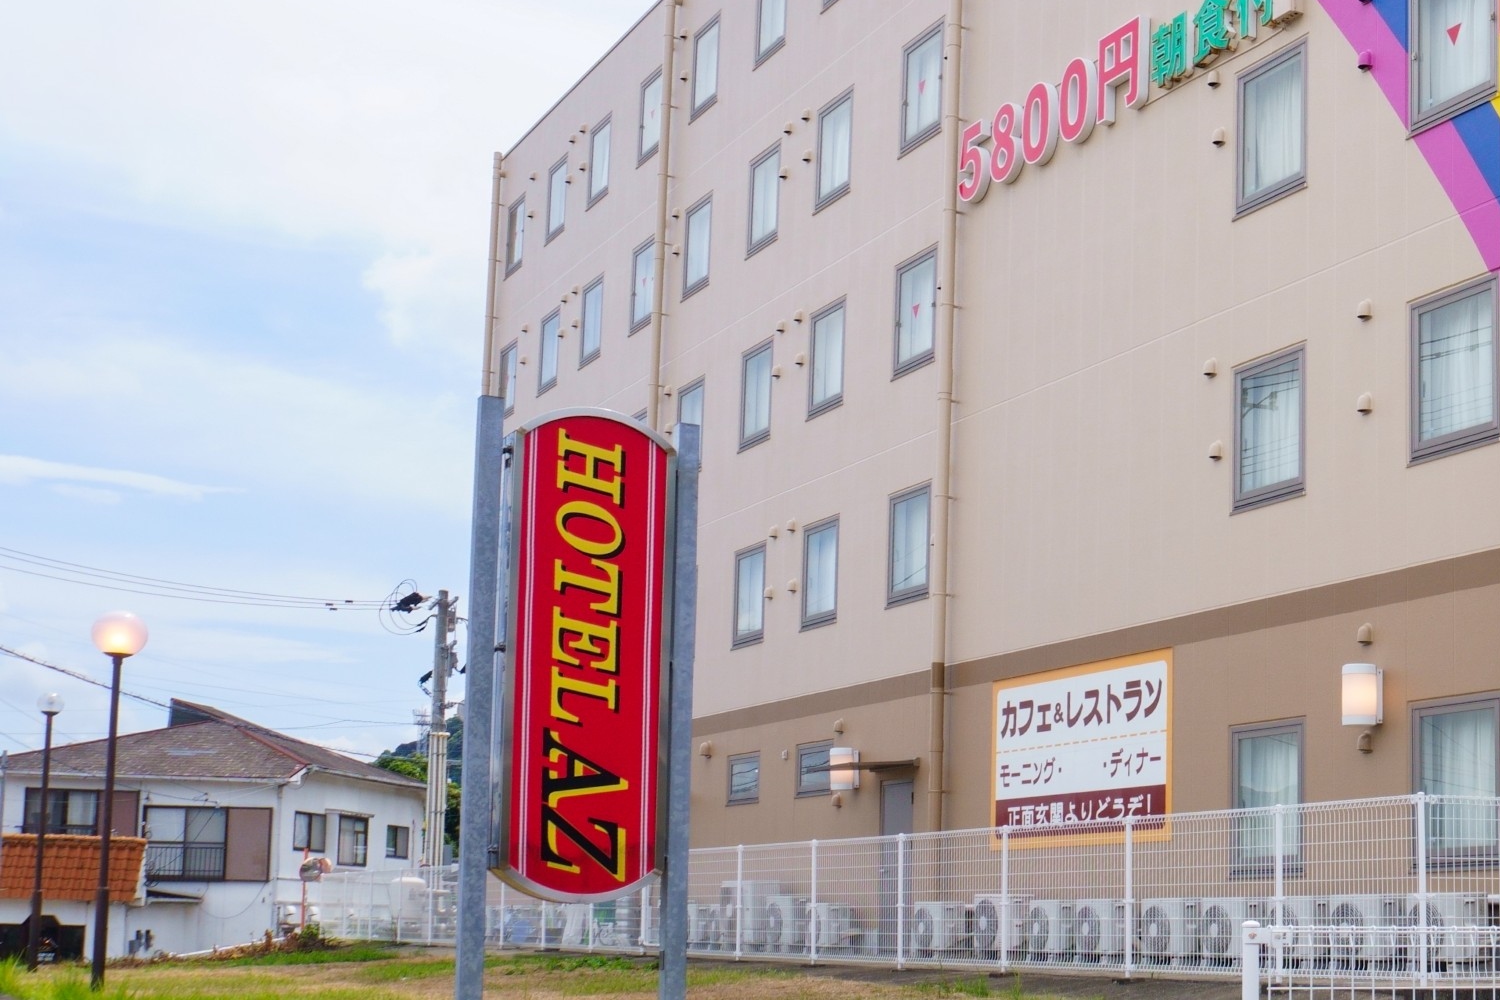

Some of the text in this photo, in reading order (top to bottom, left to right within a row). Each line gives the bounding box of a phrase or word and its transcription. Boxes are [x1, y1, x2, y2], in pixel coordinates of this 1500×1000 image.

[957, 15, 1151, 204] 5800円
[540, 427, 628, 883] HOTEL AZ
[1000, 678, 1162, 739] カフェ&レストラン
